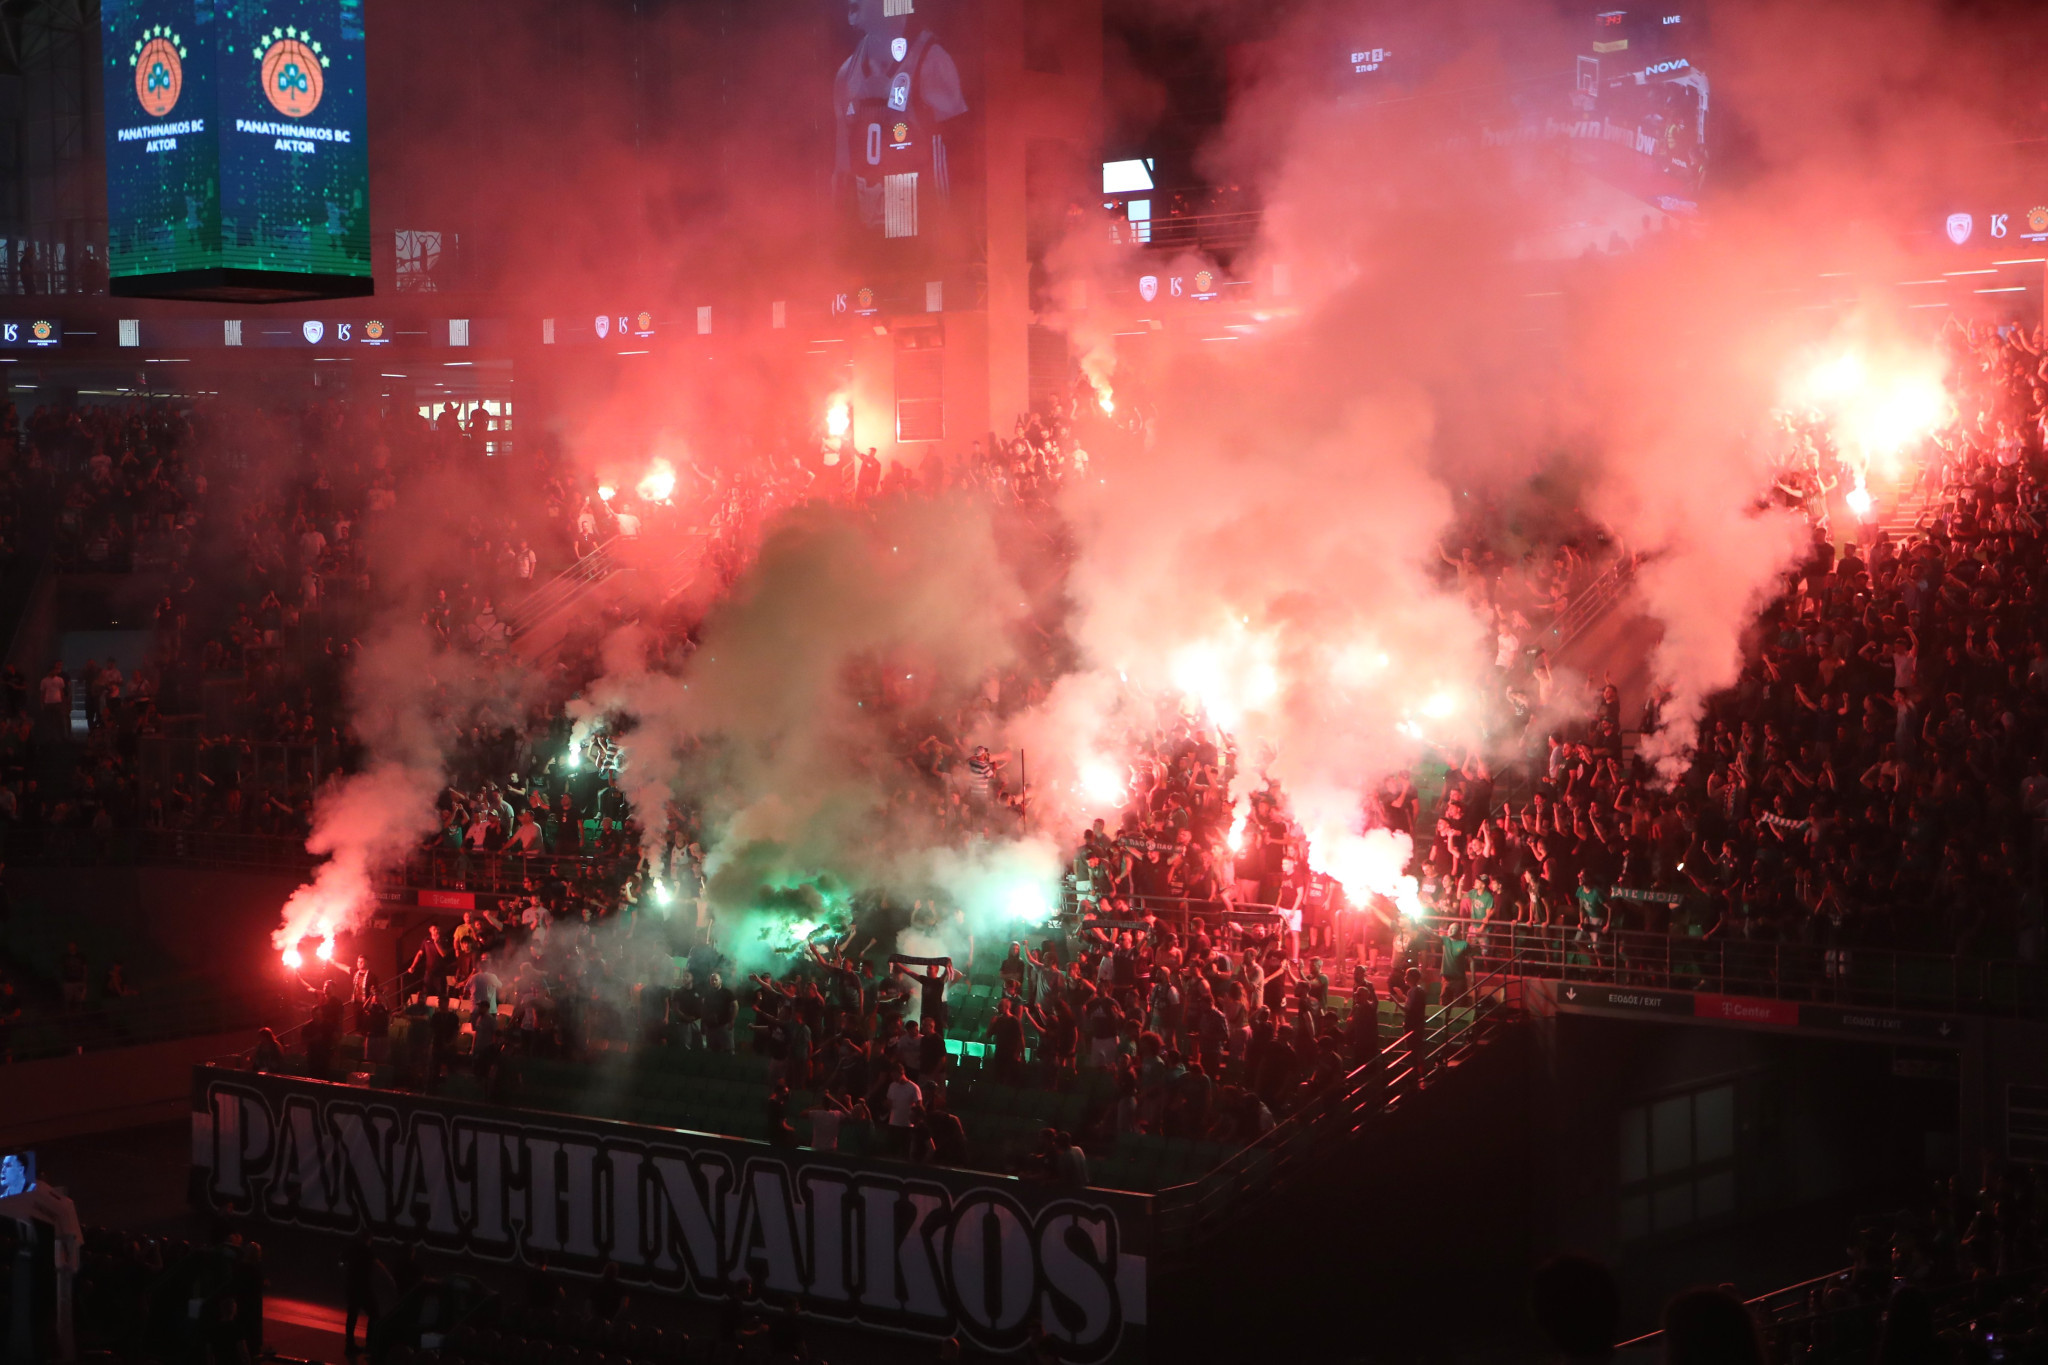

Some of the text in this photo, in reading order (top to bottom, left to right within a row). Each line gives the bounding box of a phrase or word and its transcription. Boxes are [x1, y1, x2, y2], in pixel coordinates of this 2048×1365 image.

[1662, 15, 1681, 25] LIVE
[1351, 52, 1371, 63] ΕΡΤ
[1645, 59, 1690, 76] NOVA
[118, 119, 205, 142] PANATHINAIKOS BC
[236, 119, 351, 143] PANATHINAIKOS BC
[146, 138, 177, 153] AKTOR
[274, 138, 316, 154] AKTOR
[440, 896, 461, 905] Center
[1644, 997, 1662, 1007] EXIT
[1734, 1004, 1771, 1019] Center
[211, 1088, 1116, 1350] PANATHINAIKOS
